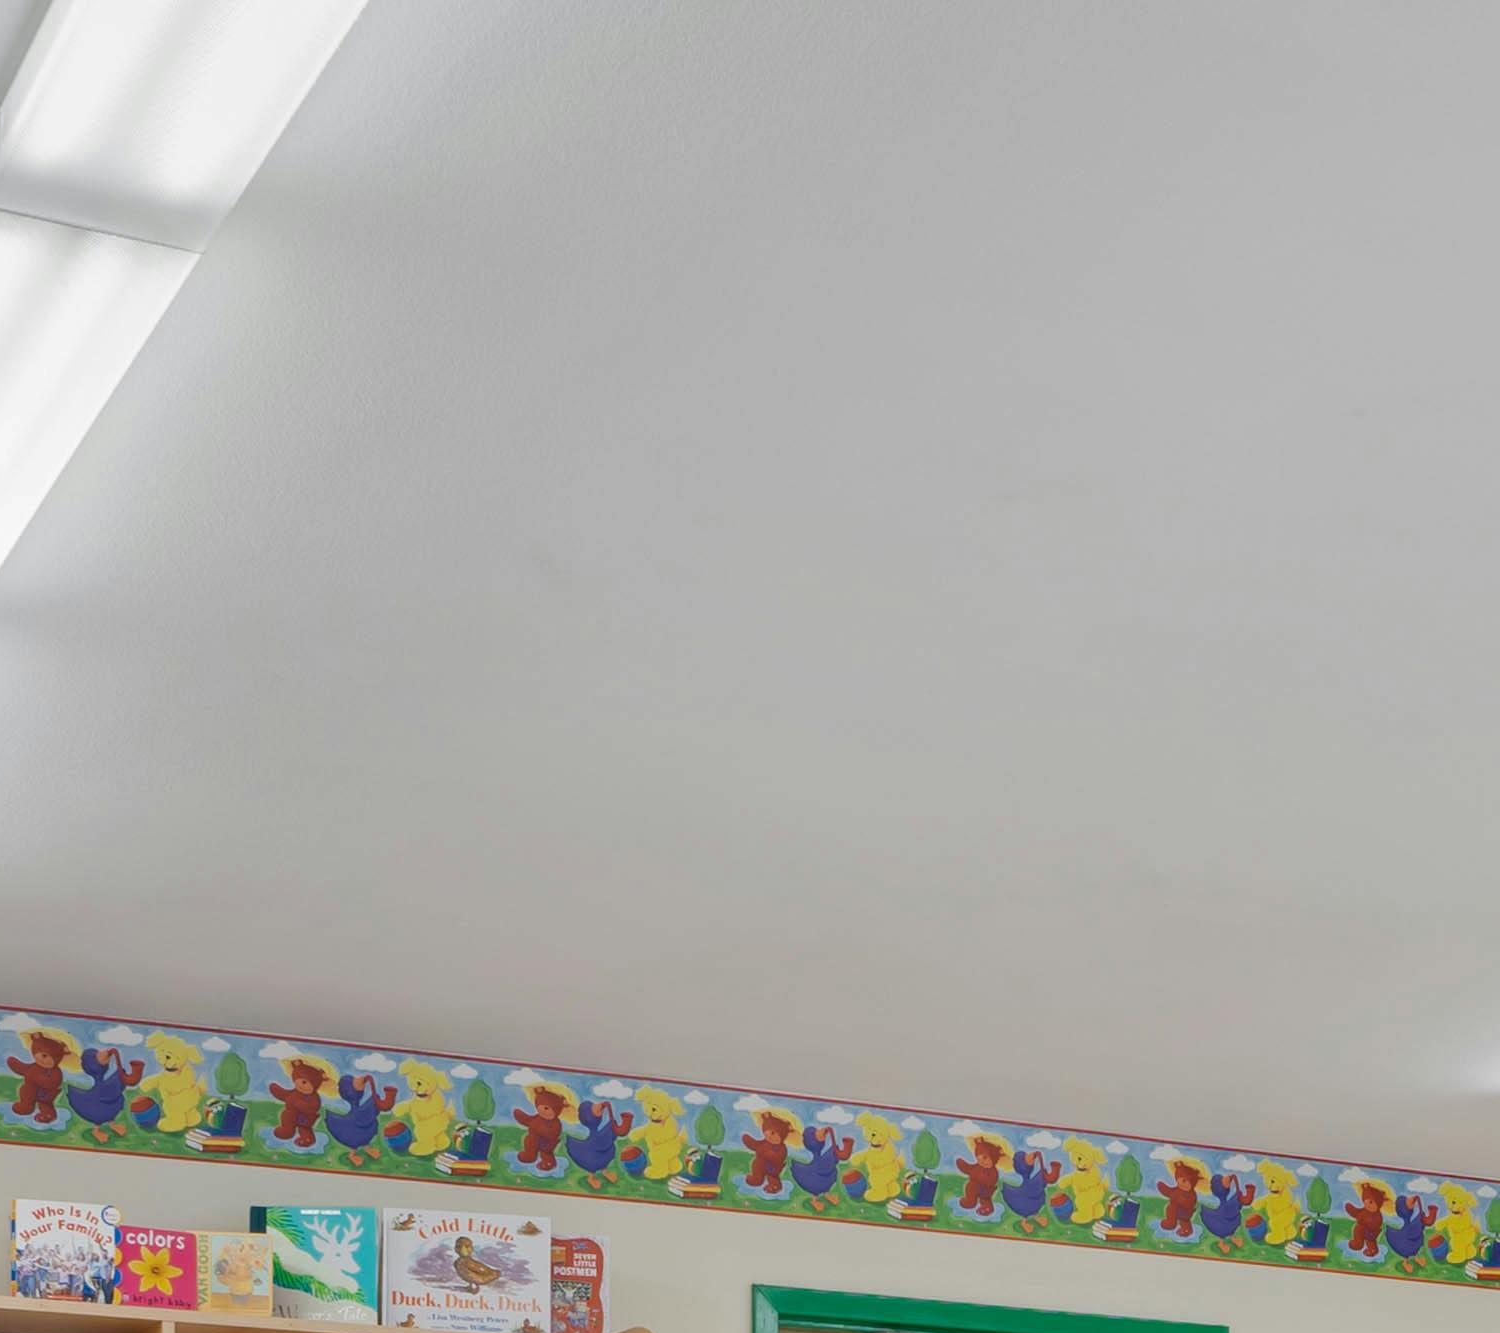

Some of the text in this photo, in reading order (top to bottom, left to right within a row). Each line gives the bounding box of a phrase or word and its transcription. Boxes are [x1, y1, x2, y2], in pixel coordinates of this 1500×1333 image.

[32, 1205, 100, 1225] Who Is In
[58, 1219, 113, 1248] Family?
[126, 1230, 186, 1250] colors
[418, 1217, 514, 1243] Cold Little
[573, 1252, 597, 1261] SEVEN
[573, 1260, 597, 1268] LITTLE
[198, 1233, 210, 1305] VAN GOGH
[553, 1266, 598, 1278] POSTMEN
[390, 1290, 543, 1313] Duck, Duck, Duck
